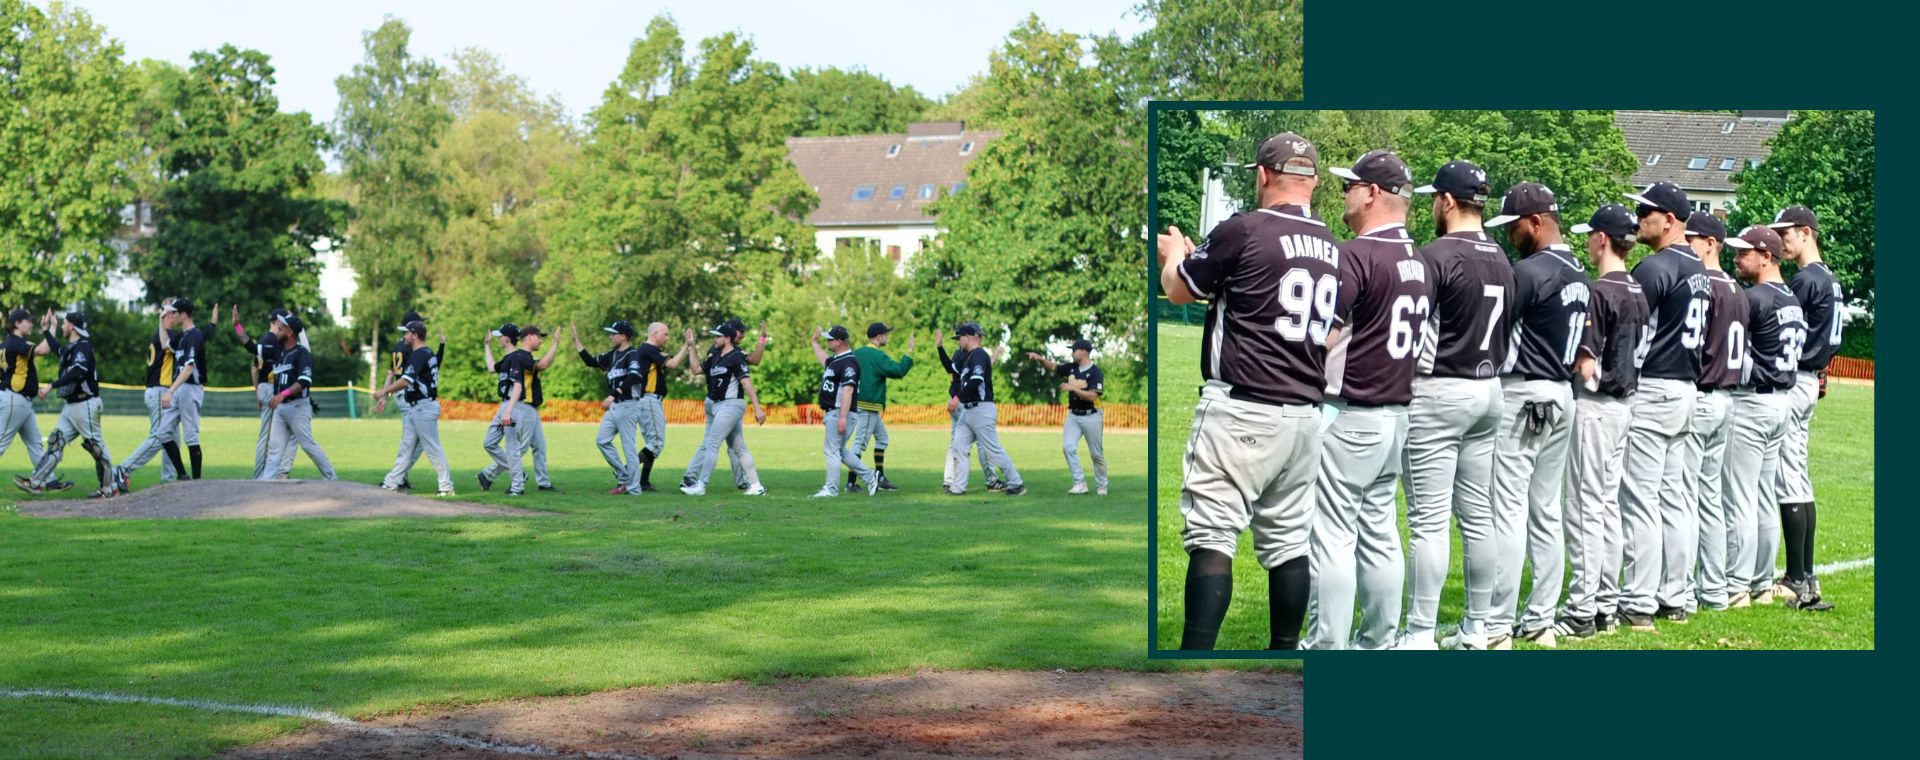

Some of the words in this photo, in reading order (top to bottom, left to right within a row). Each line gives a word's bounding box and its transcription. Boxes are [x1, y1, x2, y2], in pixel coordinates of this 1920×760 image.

[1274, 267, 1338, 345] 99
[1387, 294, 1430, 359] 63
[1479, 284, 1504, 351] 7
[392, 351, 404, 375] 12
[1563, 311, 1586, 365] 11
[1727, 320, 1744, 370] 0
[822, 379, 835, 393] 63
